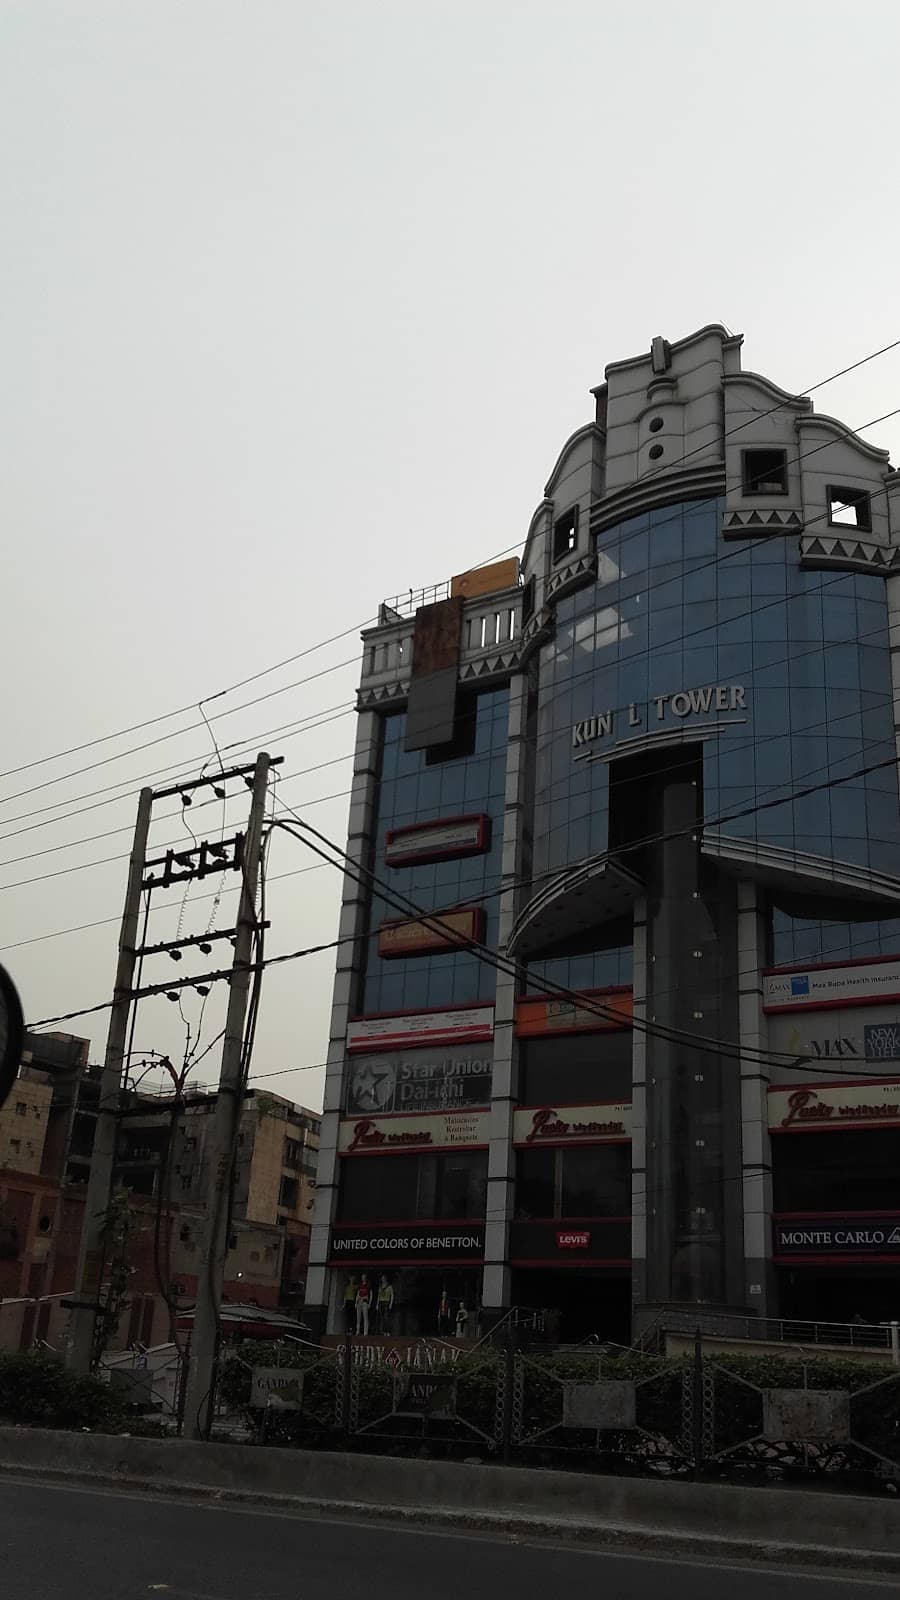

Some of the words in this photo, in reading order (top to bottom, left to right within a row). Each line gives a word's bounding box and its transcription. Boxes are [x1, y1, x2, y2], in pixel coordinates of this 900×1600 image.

[572, 709, 614, 747] KUN
[654, 685, 747, 721] TOWER
[847, 976, 870, 986] Health
[870, 1028, 897, 1041] NEW
[810, 1037, 858, 1057] MAX
[401, 1062, 436, 1080] Star
[442, 1056, 492, 1076] Union
[401, 1078, 464, 1101] Dai-ichi
[333, 1238, 368, 1250] UNITED
[369, 1237, 409, 1249] COLORS
[410, 1237, 424, 1248] OF
[781, 1231, 831, 1245] MONTE
[834, 1230, 884, 1244] CARLO
